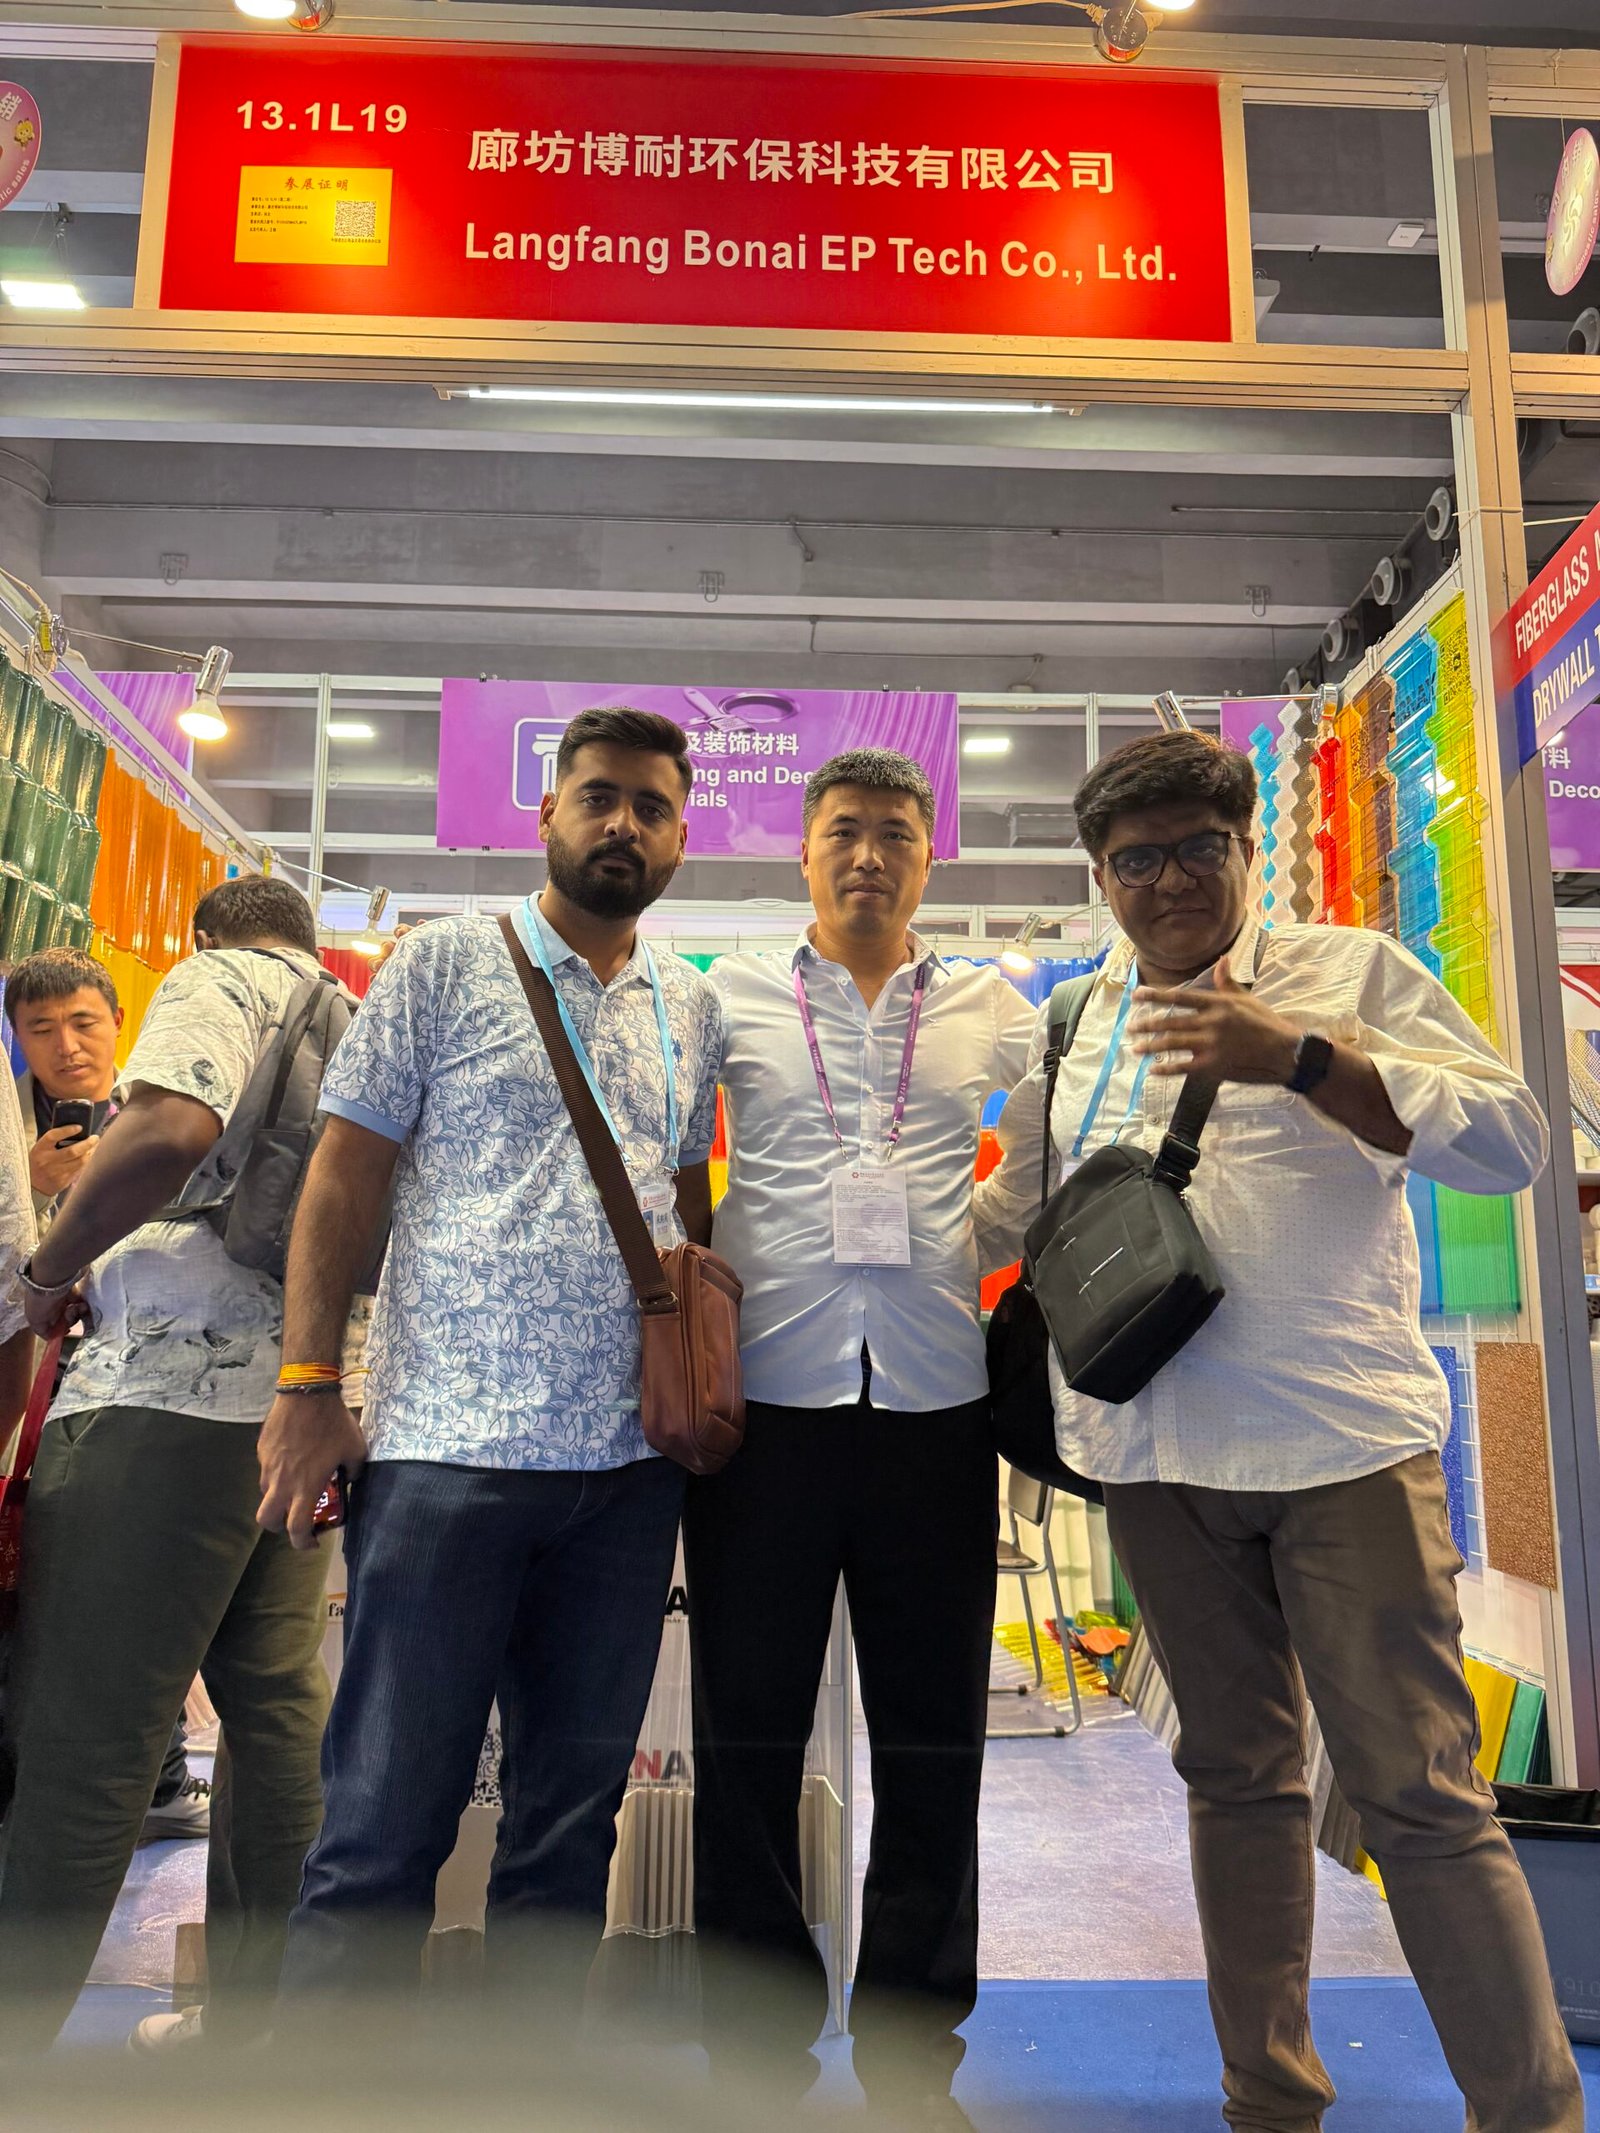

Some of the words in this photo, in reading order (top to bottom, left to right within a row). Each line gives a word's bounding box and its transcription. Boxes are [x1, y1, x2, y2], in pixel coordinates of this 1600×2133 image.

[237, 101, 407, 133] 13.1L19
[467, 128, 1114, 194] 廊坊博耐环保科技有限公司
[465, 222, 669, 274] Langfang
[684, 229, 807, 271] Bonai
[821, 234, 877, 272] EP
[888, 237, 988, 276] Tech
[1000, 240, 1084, 286] Co.,
[1097, 243, 1177, 281] Ltd.
[1515, 545, 1590, 660] FIBERGLASS
[1532, 638, 1595, 729] DRYWALL
[689, 788, 728, 808] ials
[692, 768, 720, 787] ng
[727, 766, 768, 784] and
[774, 766, 814, 785] Dec
